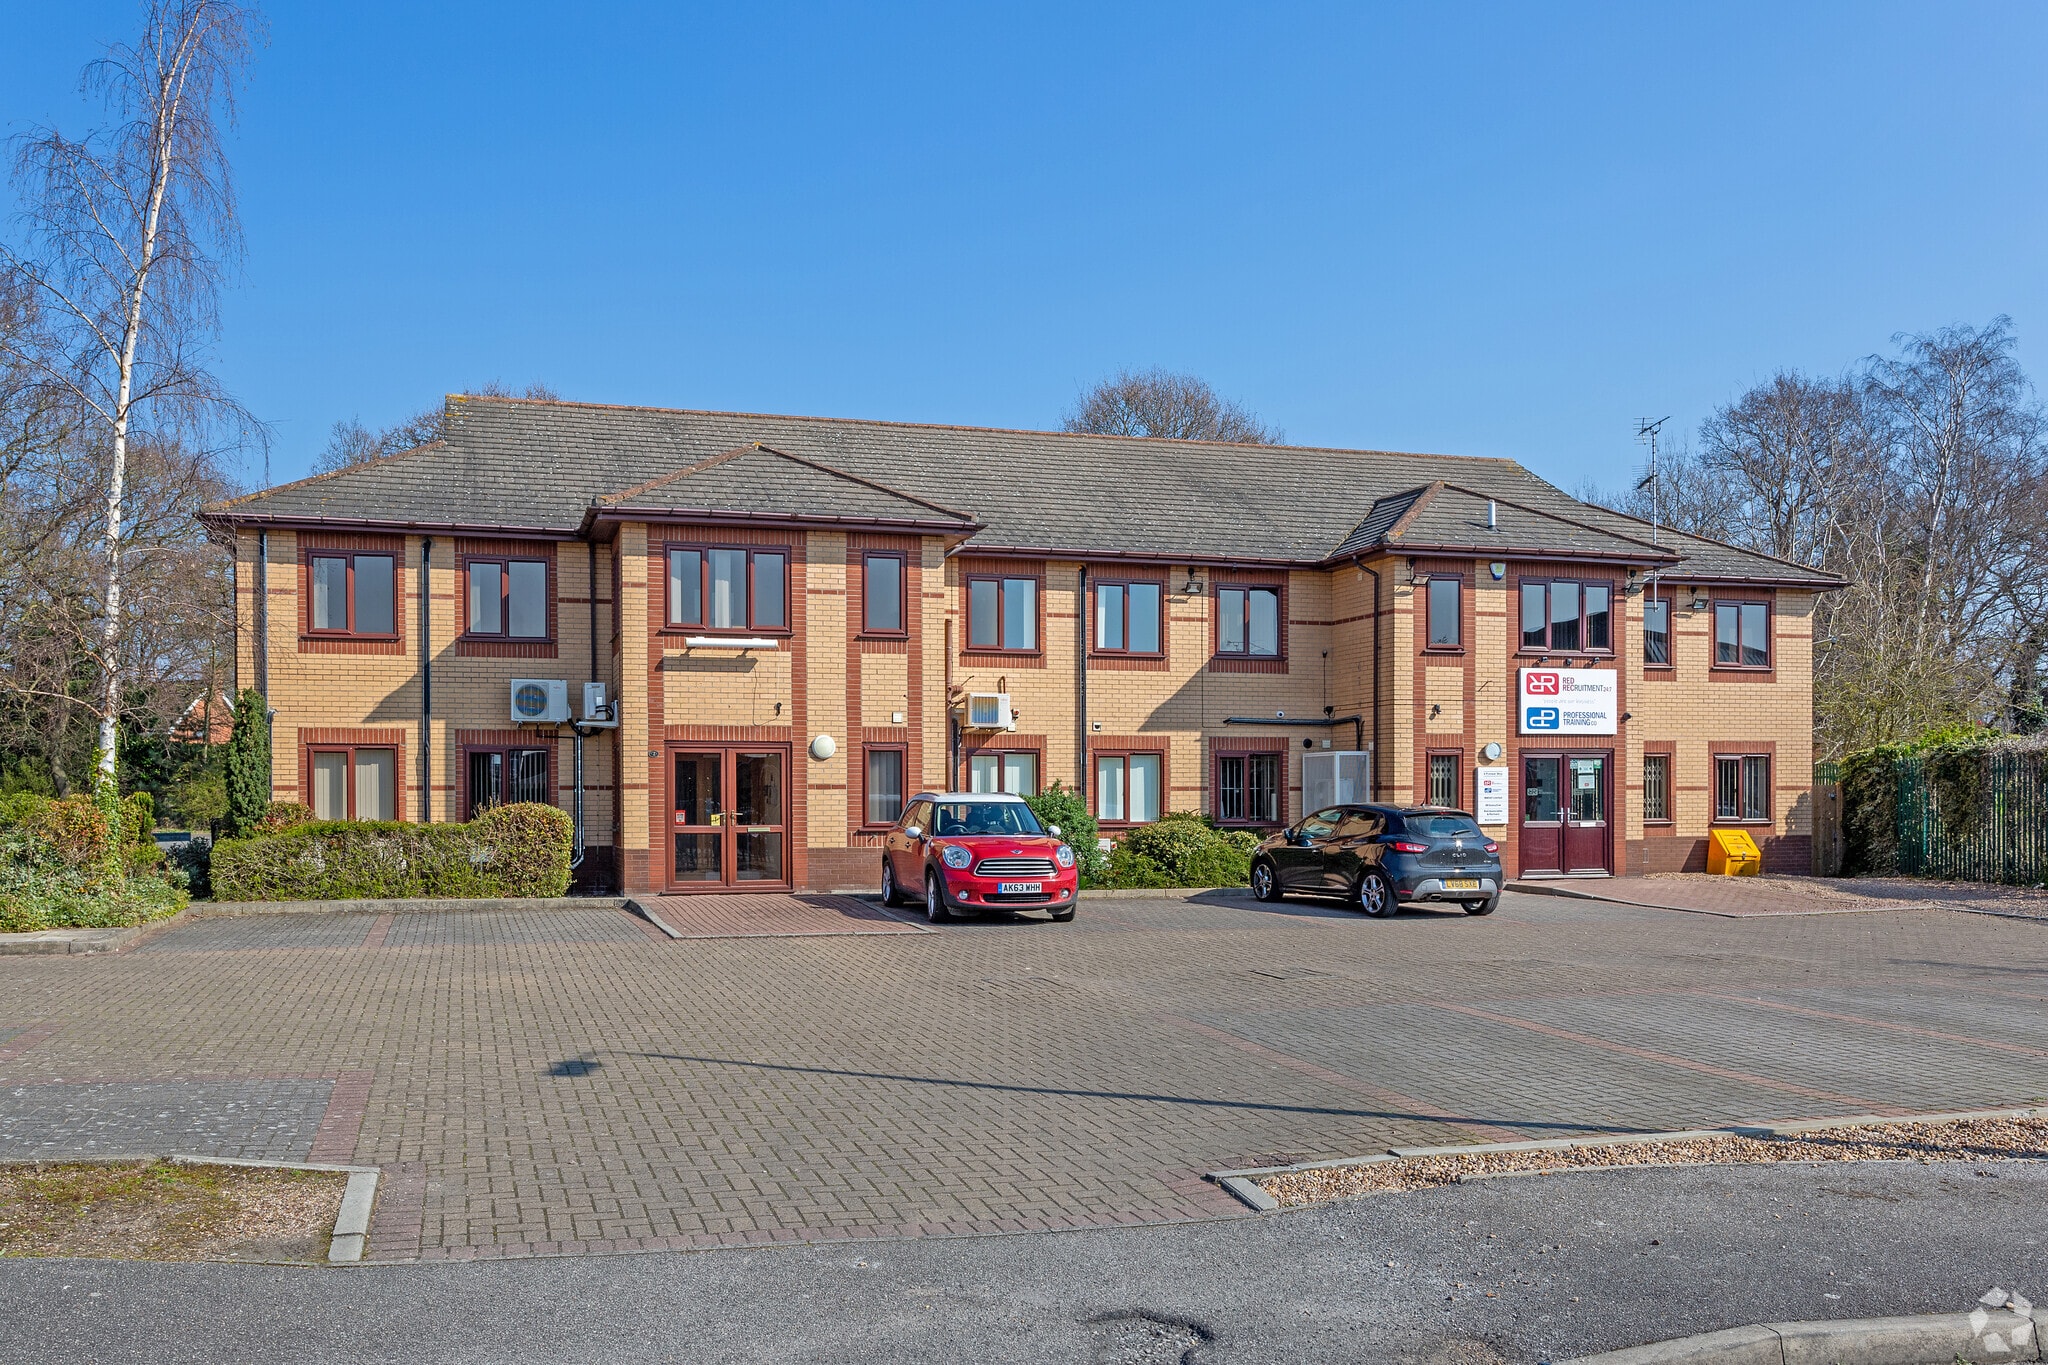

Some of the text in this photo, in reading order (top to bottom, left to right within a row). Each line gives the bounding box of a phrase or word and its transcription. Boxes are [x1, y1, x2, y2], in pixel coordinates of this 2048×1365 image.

[1562, 684, 1603, 692] RECRUITMENT
[1563, 711, 1607, 719] PROFESSIONAL
[1003, 883, 1041, 892] AK63 WHH
